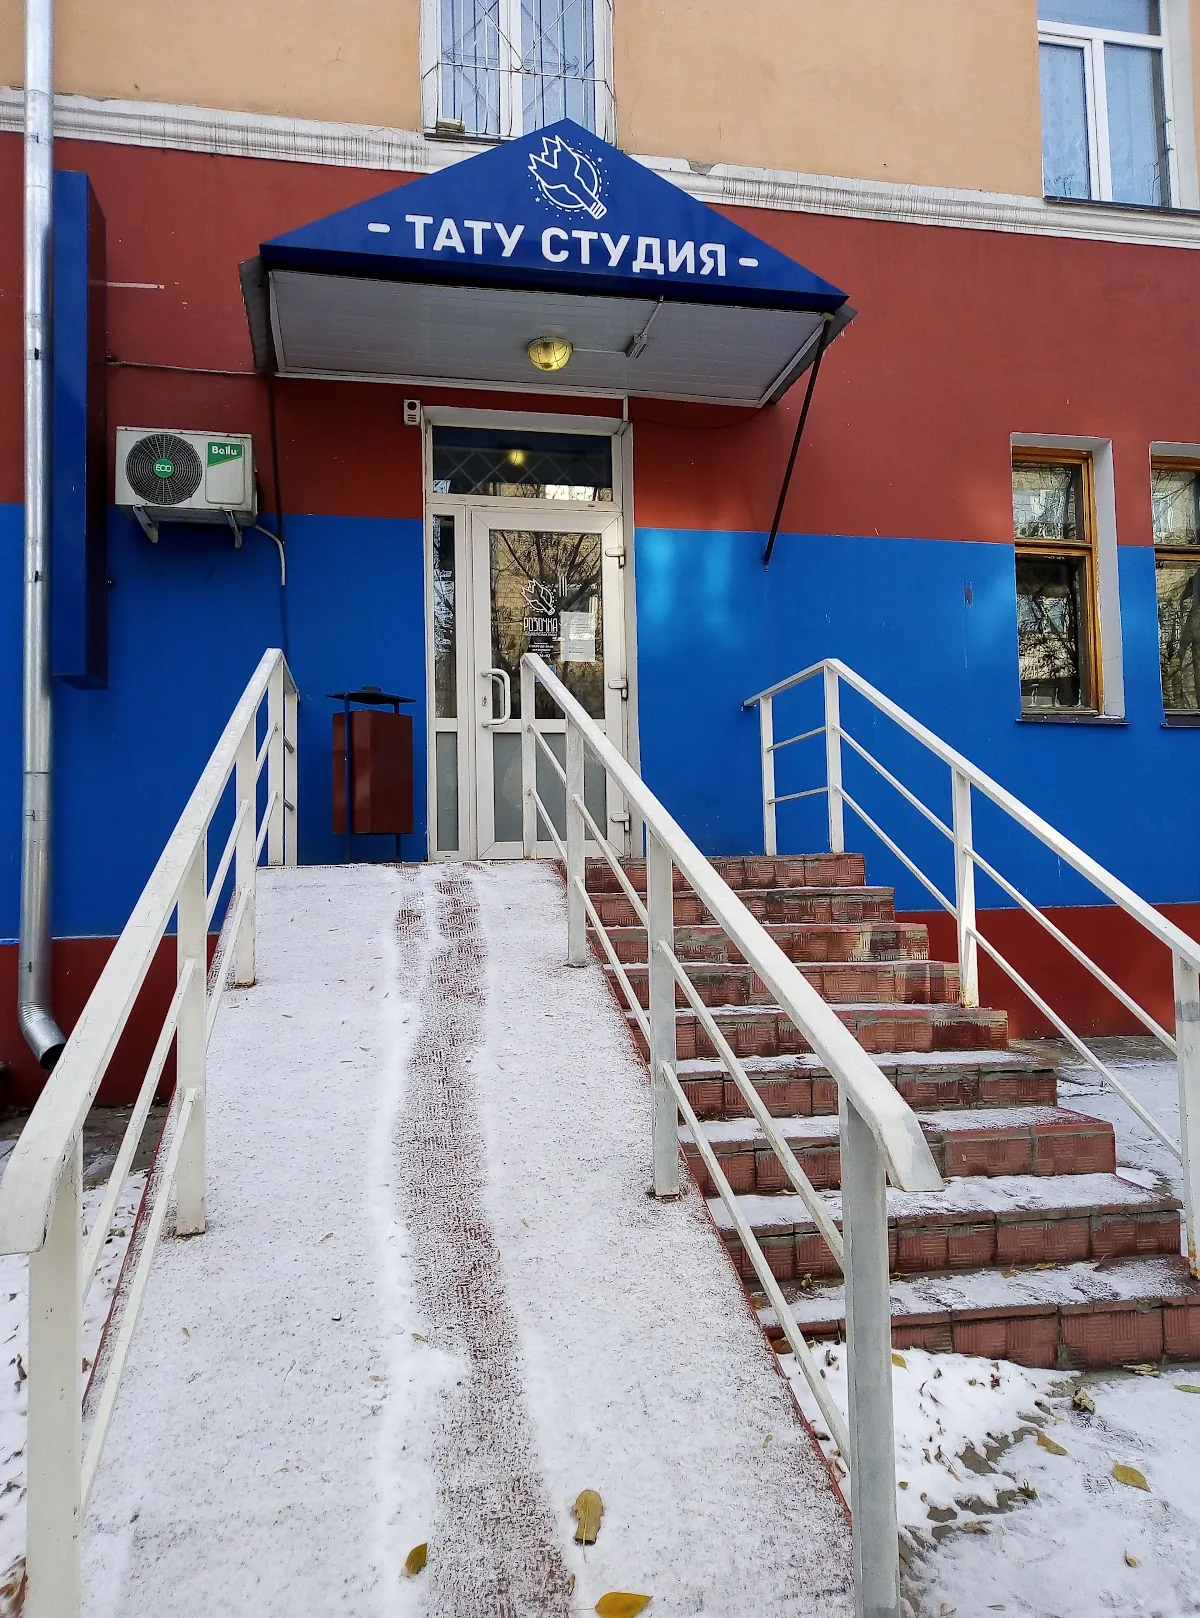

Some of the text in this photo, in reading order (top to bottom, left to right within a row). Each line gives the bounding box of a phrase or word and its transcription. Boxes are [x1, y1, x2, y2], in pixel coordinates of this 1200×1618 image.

[405, 214, 726, 276] ТАТУ СТУДИЯ
[212, 445, 237, 455] Ballu
[156, 464, 171, 472] ECO
[523, 617, 558, 632] РОЗОЧКА
